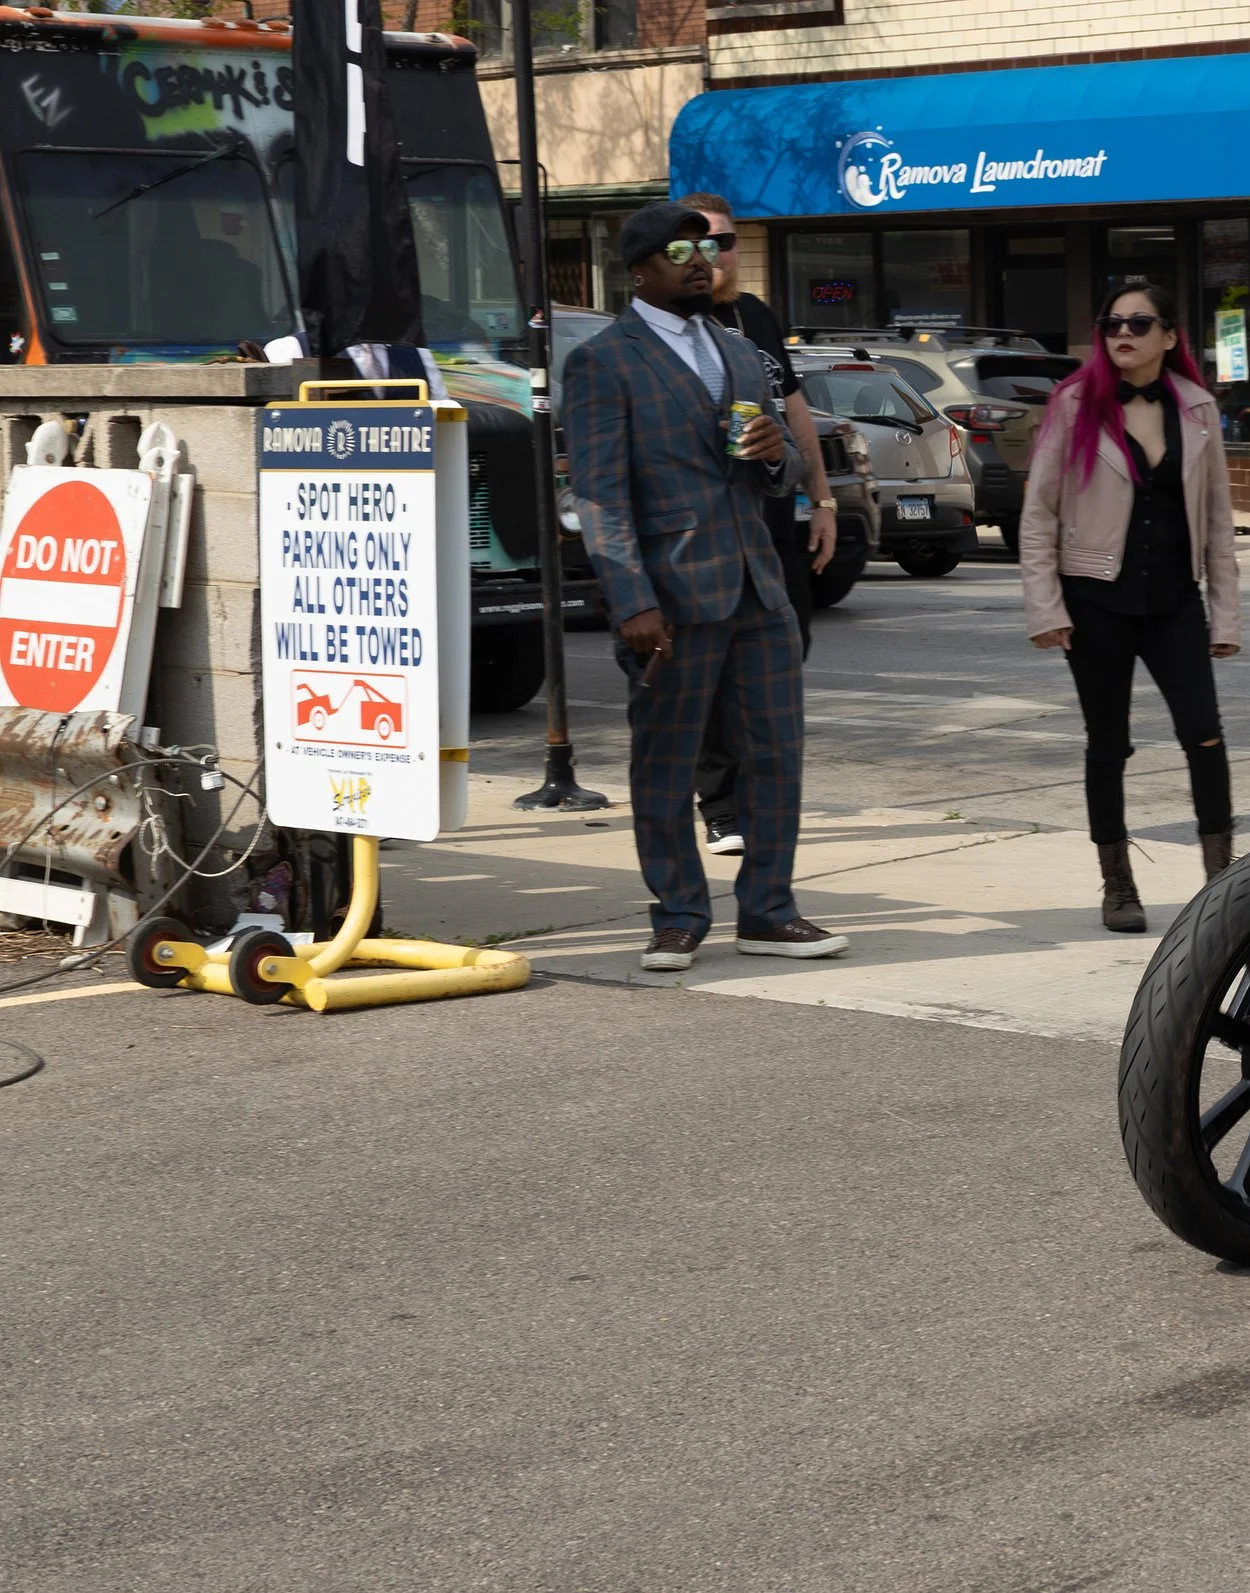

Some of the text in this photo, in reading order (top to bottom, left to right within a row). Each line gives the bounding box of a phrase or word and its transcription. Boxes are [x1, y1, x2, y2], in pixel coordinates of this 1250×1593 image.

[878, 149, 1108, 200] Ramova Laundromat
[811, 286, 854, 300] OPEN
[263, 426, 432, 453] RAMOVA THEATRE
[297, 482, 396, 522] SPOT HERO
[16, 534, 118, 576] DO NOT
[282, 530, 412, 571] PARKING ONLY
[292, 575, 409, 618] ALL OTHERS
[9, 631, 96, 673] ENTER
[275, 622, 422, 667] WILL BE TOWED
[303, 746, 335, 758] VEHICLE
[338, 749, 372, 761] OWNER'S
[375, 751, 411, 764] EXPENSE
